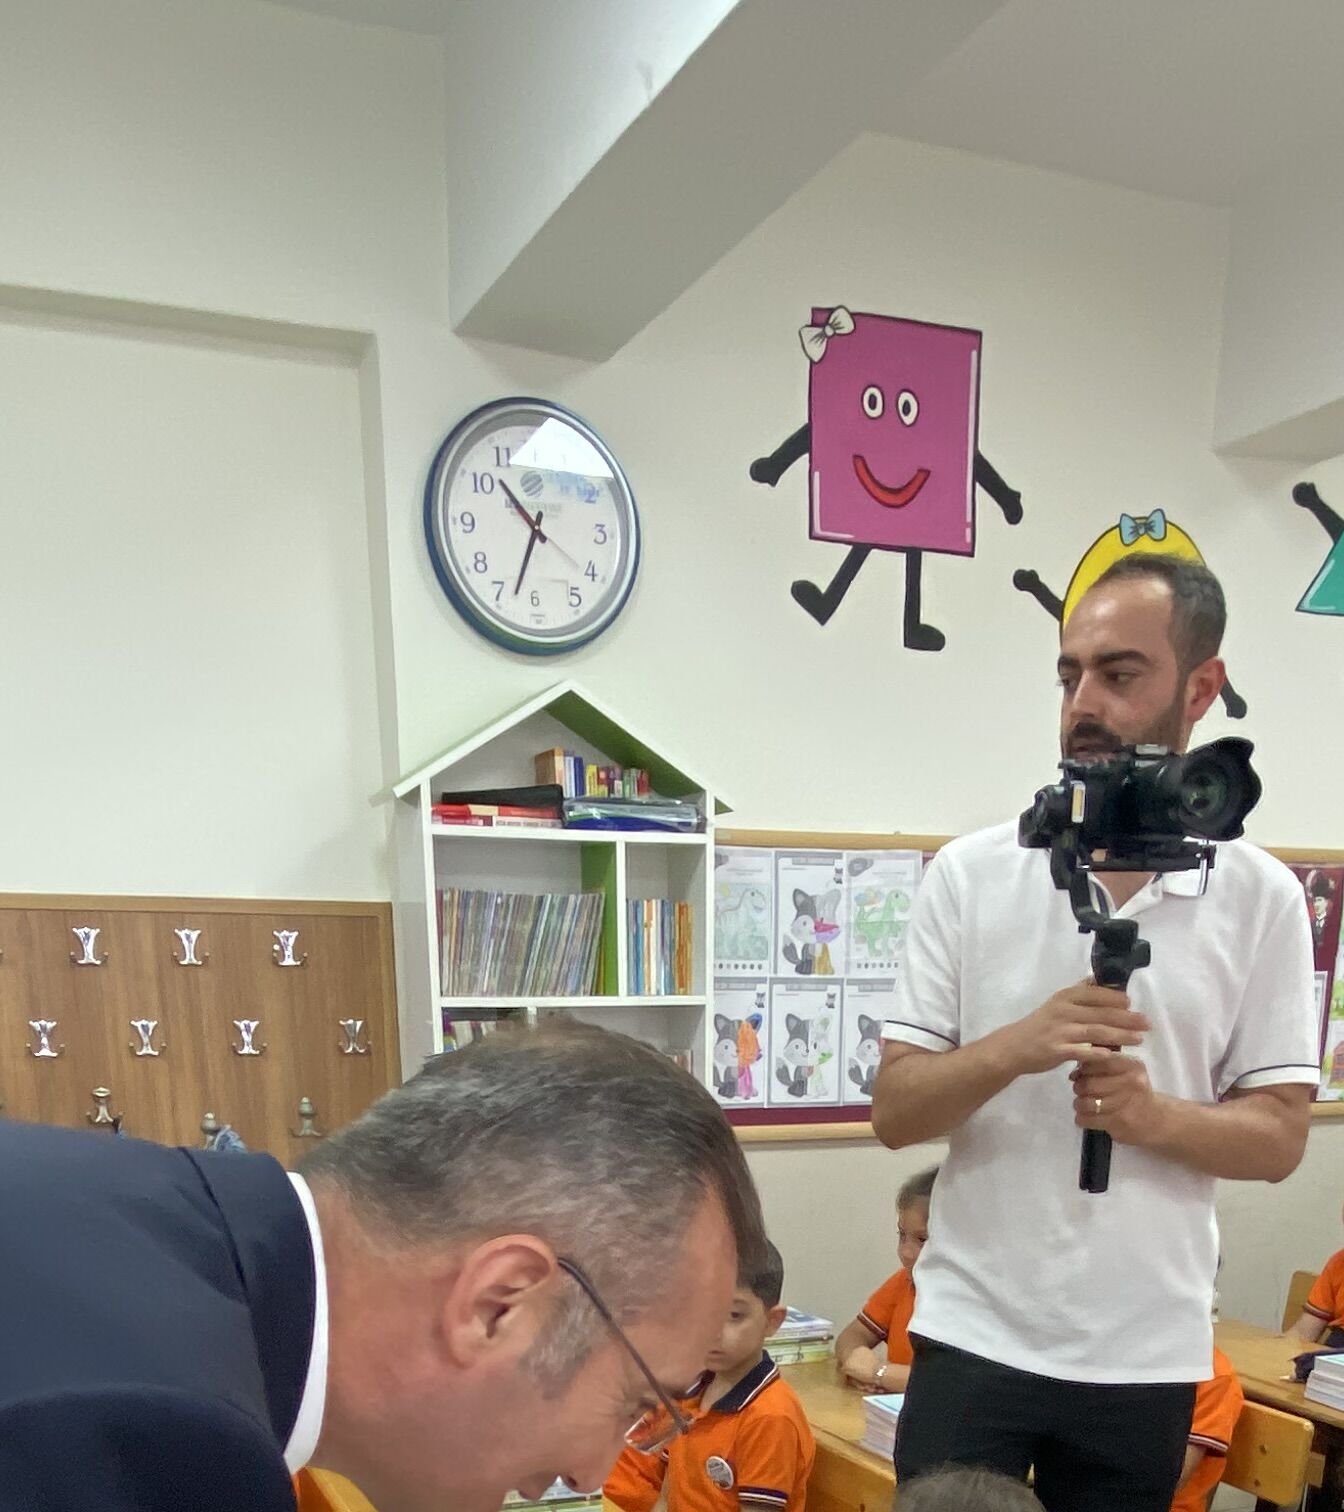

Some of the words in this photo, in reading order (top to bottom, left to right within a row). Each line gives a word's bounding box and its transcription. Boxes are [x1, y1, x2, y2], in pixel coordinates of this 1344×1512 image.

[493, 447, 511, 467] 11
[472, 472, 495, 495] 10
[460, 512, 476, 534] 9
[593, 523, 607, 545] 3
[473, 552, 488, 573] 8
[584, 560, 599, 582] 4
[491, 581, 504, 602] 7
[530, 590, 540, 607] 6
[569, 587, 582, 608] 5
